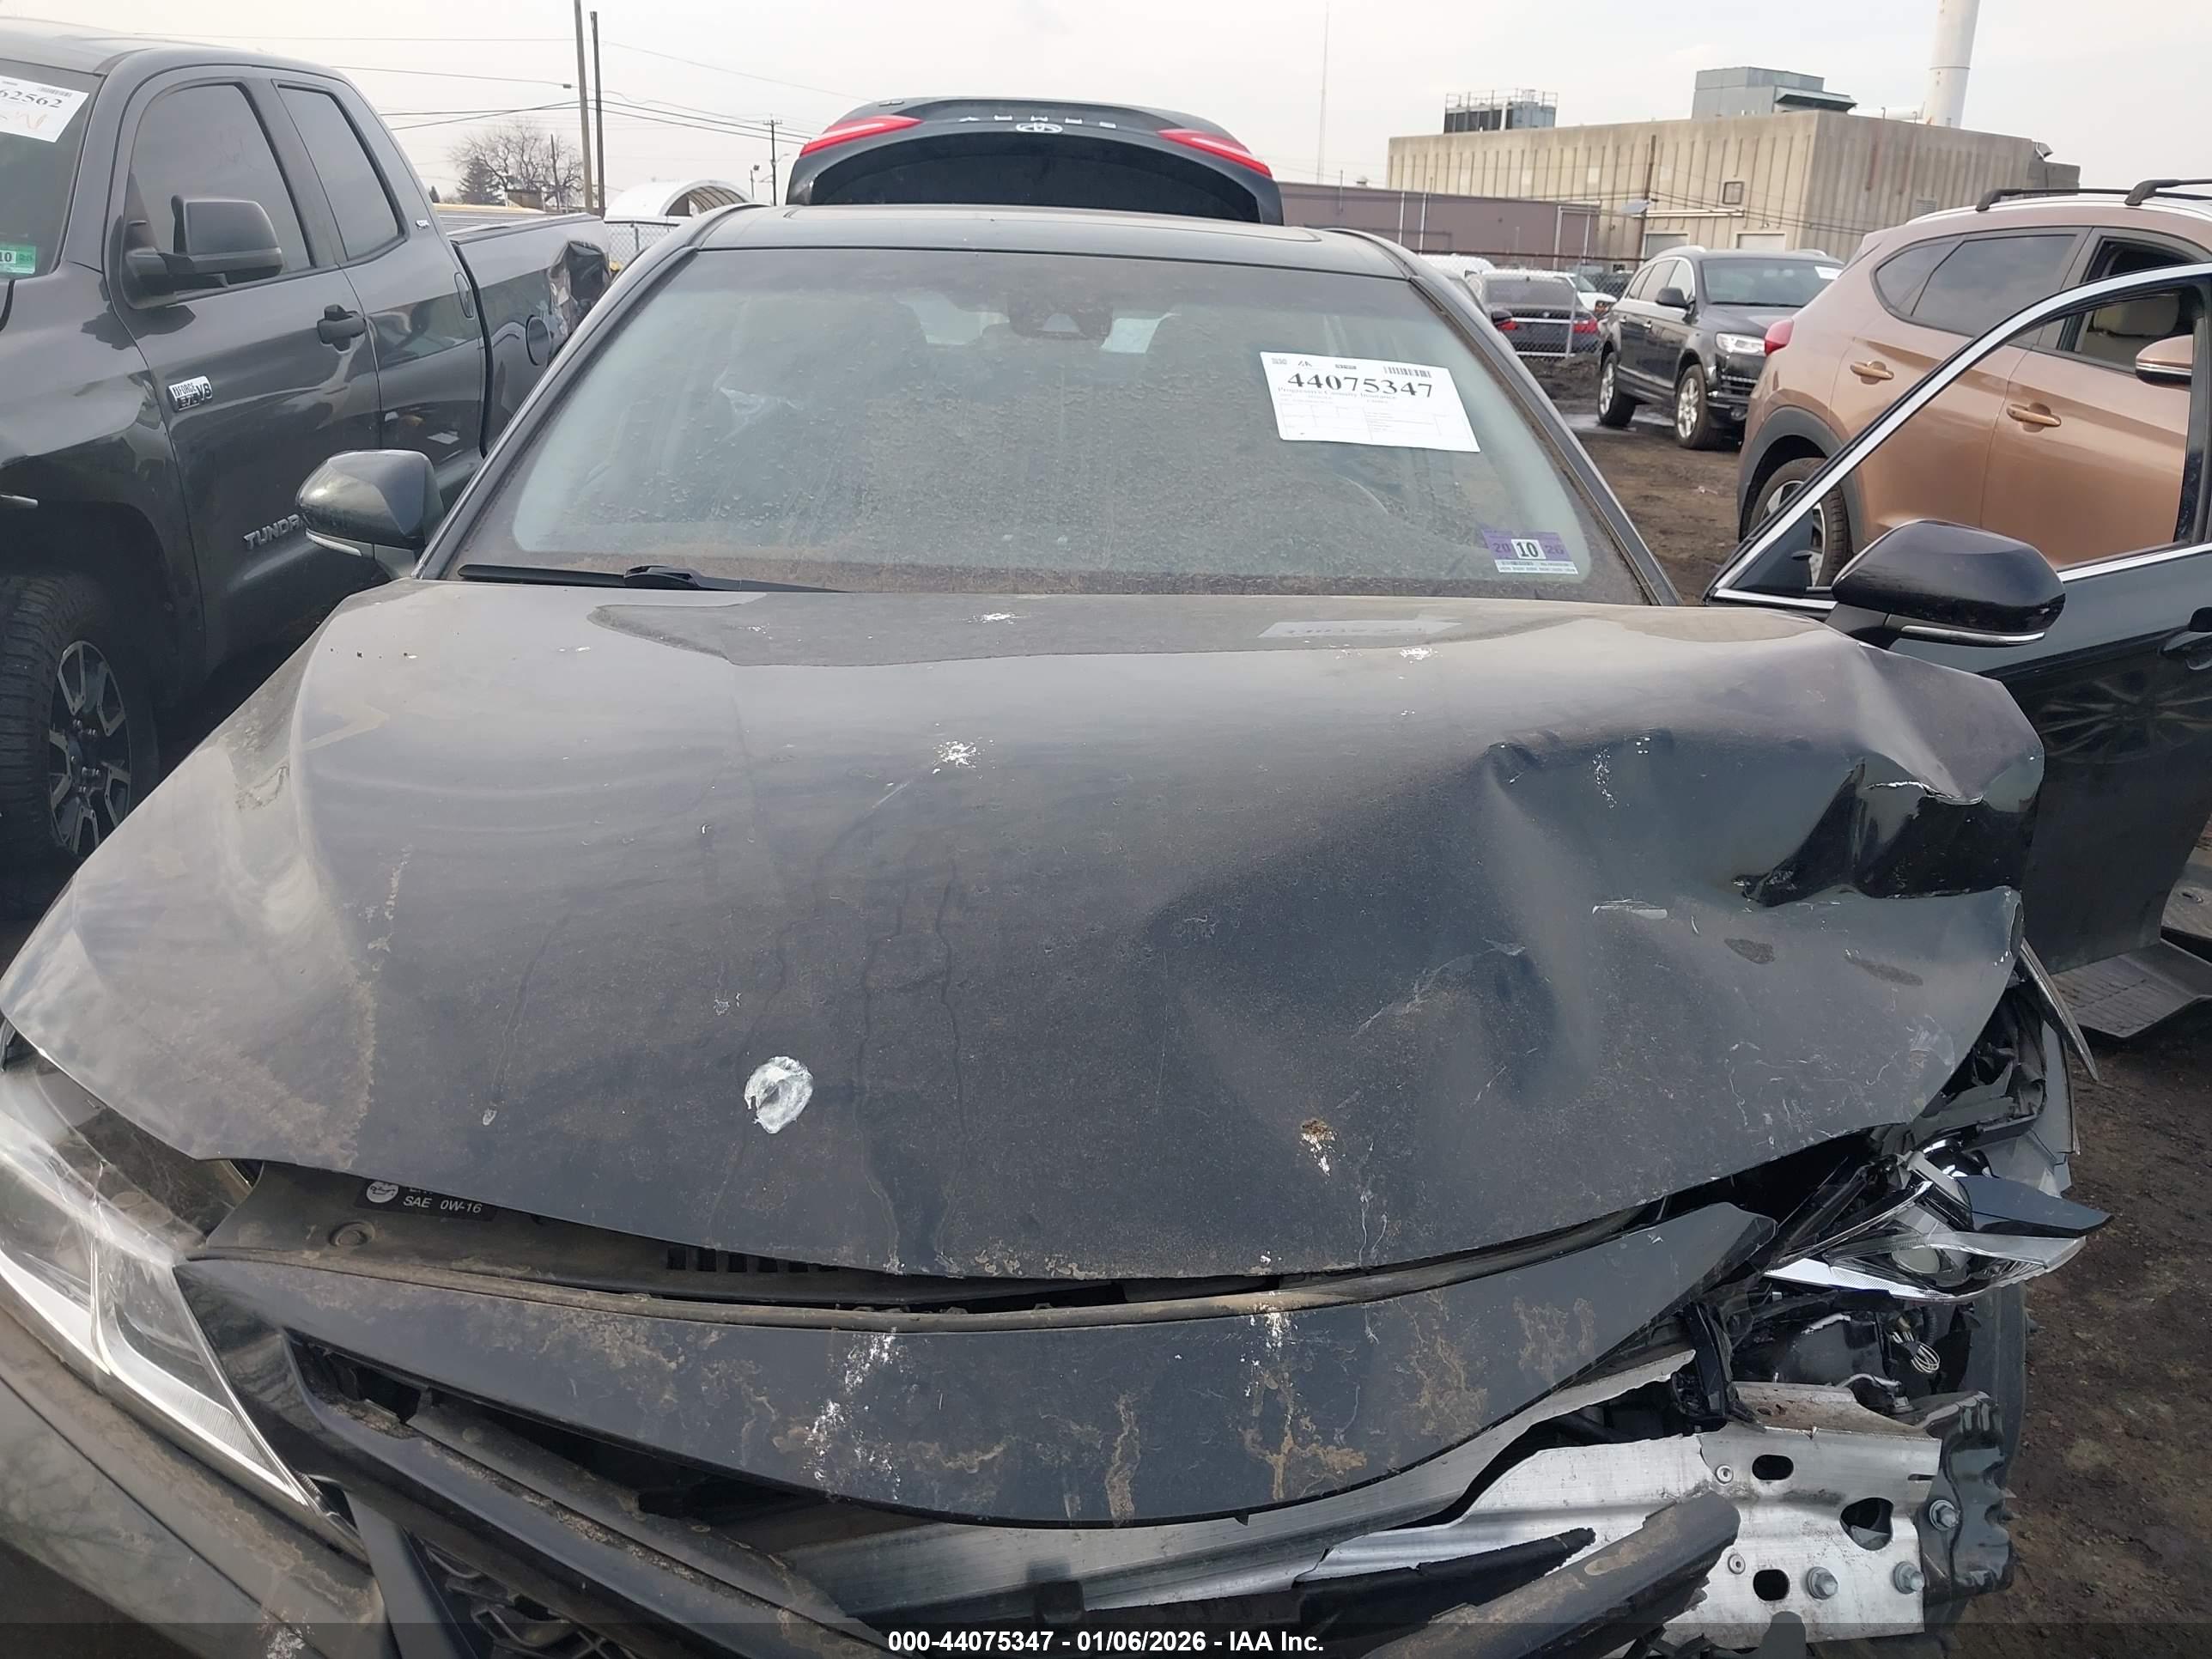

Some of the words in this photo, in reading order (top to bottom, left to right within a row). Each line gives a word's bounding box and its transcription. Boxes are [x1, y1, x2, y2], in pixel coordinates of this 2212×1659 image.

[196, 383, 212, 399] V8
[1287, 373, 1432, 398] 44075347
[244, 514, 302, 550] TUNDR
[1516, 541, 1539, 557] 10
[403, 1195, 433, 1208] SAE
[440, 1199, 483, 1214] 0W-16
